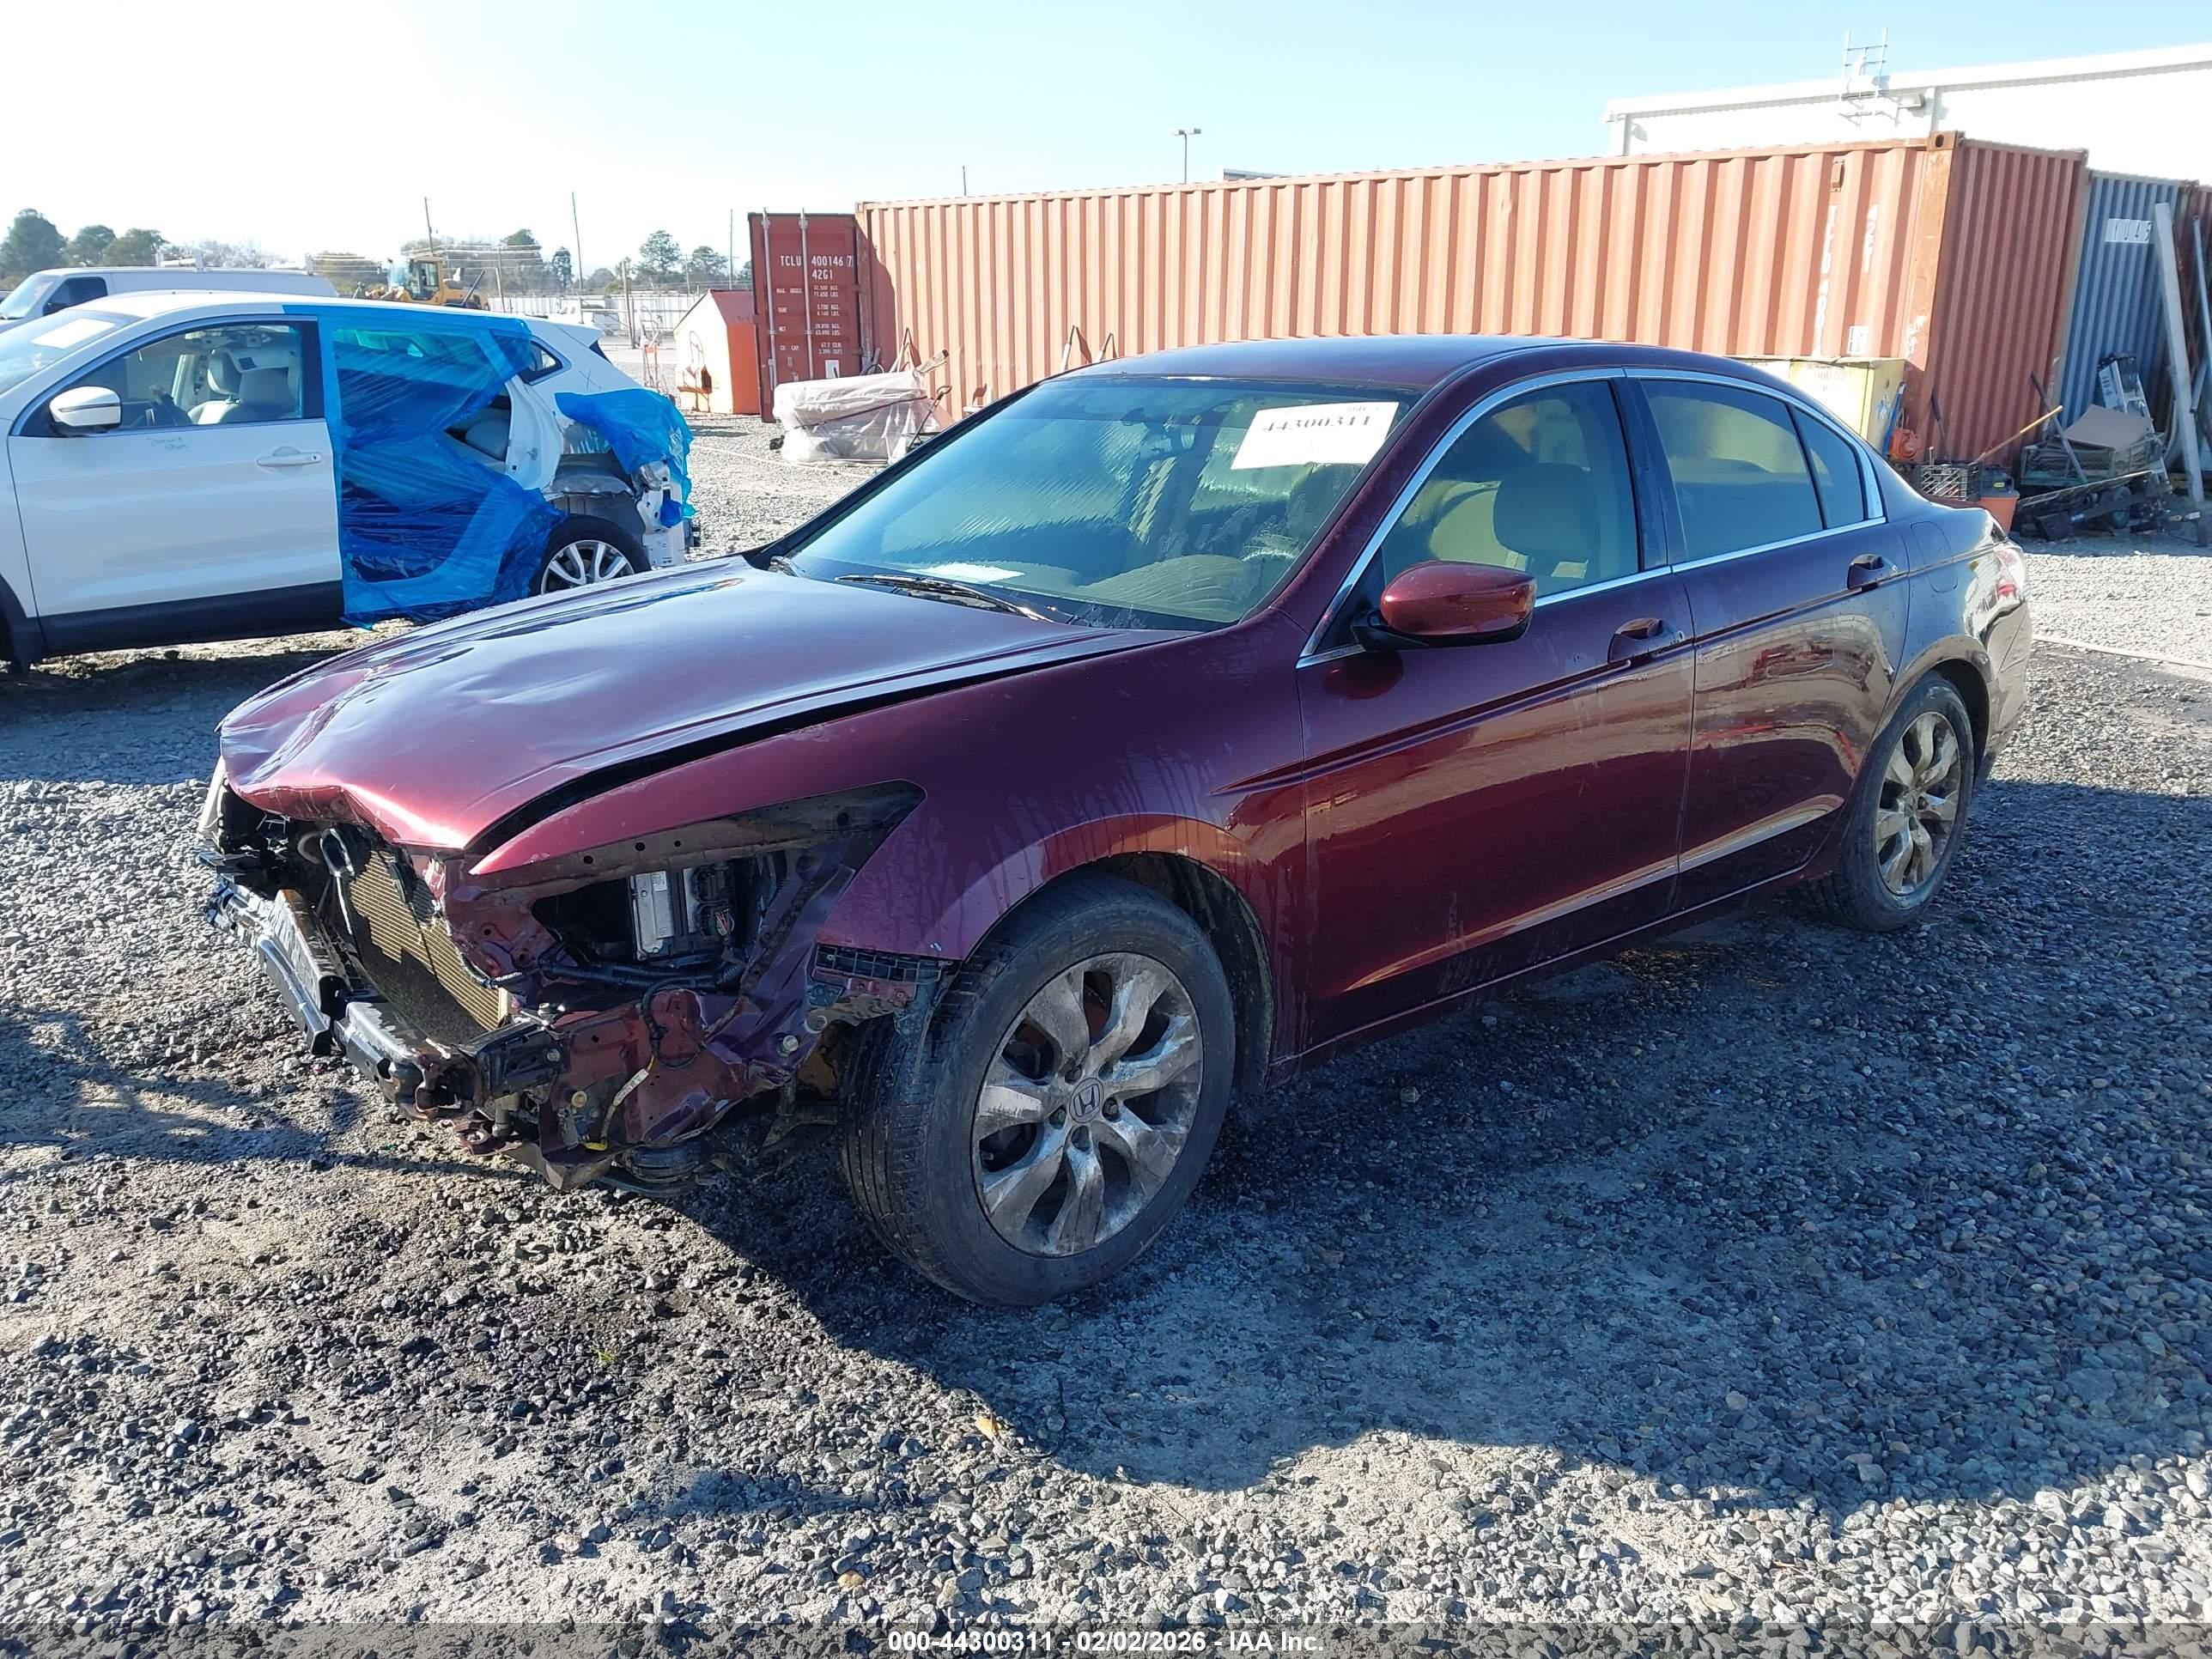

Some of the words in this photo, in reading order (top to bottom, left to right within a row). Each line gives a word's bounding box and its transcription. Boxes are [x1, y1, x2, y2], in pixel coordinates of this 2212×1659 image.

[780, 255, 802, 266] TCLU
[811, 255, 843, 267] 400146
[847, 254, 854, 267] 7
[811, 269, 833, 280] 42G1
[1262, 415, 1370, 432] 44300311
